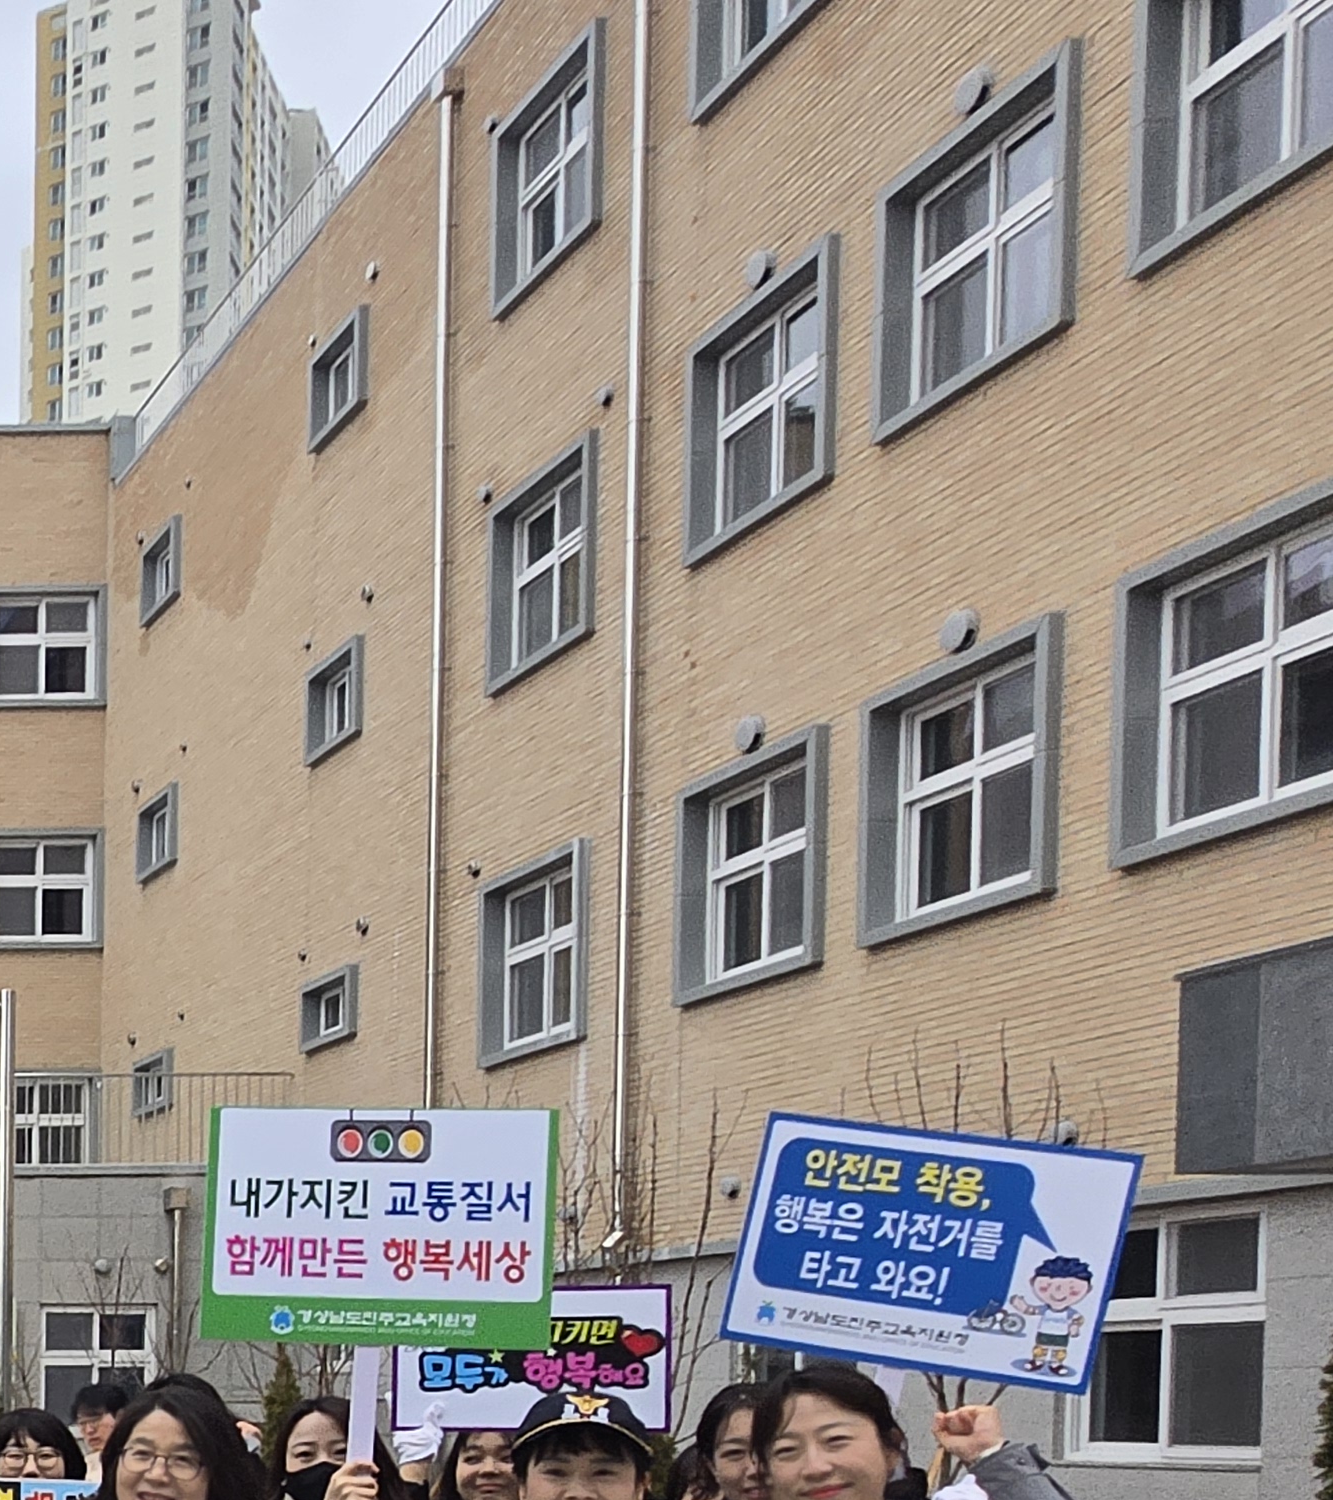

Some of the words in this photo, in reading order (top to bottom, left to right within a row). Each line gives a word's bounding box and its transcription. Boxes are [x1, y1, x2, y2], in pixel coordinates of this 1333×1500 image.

[230, 1177, 370, 1221] 내가지킨
[384, 1180, 532, 1223] 교통질서
[804, 1148, 901, 1193] 안전모
[916, 1160, 991, 1212] 착용,
[773, 1193, 865, 1242] 행복은
[873, 1209, 1004, 1262] 자전거를
[226, 1235, 368, 1280] 함께만든
[383, 1238, 532, 1284] 행복세상
[798, 1250, 861, 1289] 타고
[871, 1259, 951, 1306] 와요!
[422, 1353, 509, 1390] 모두가
[522, 1351, 646, 1391] 행복해요
